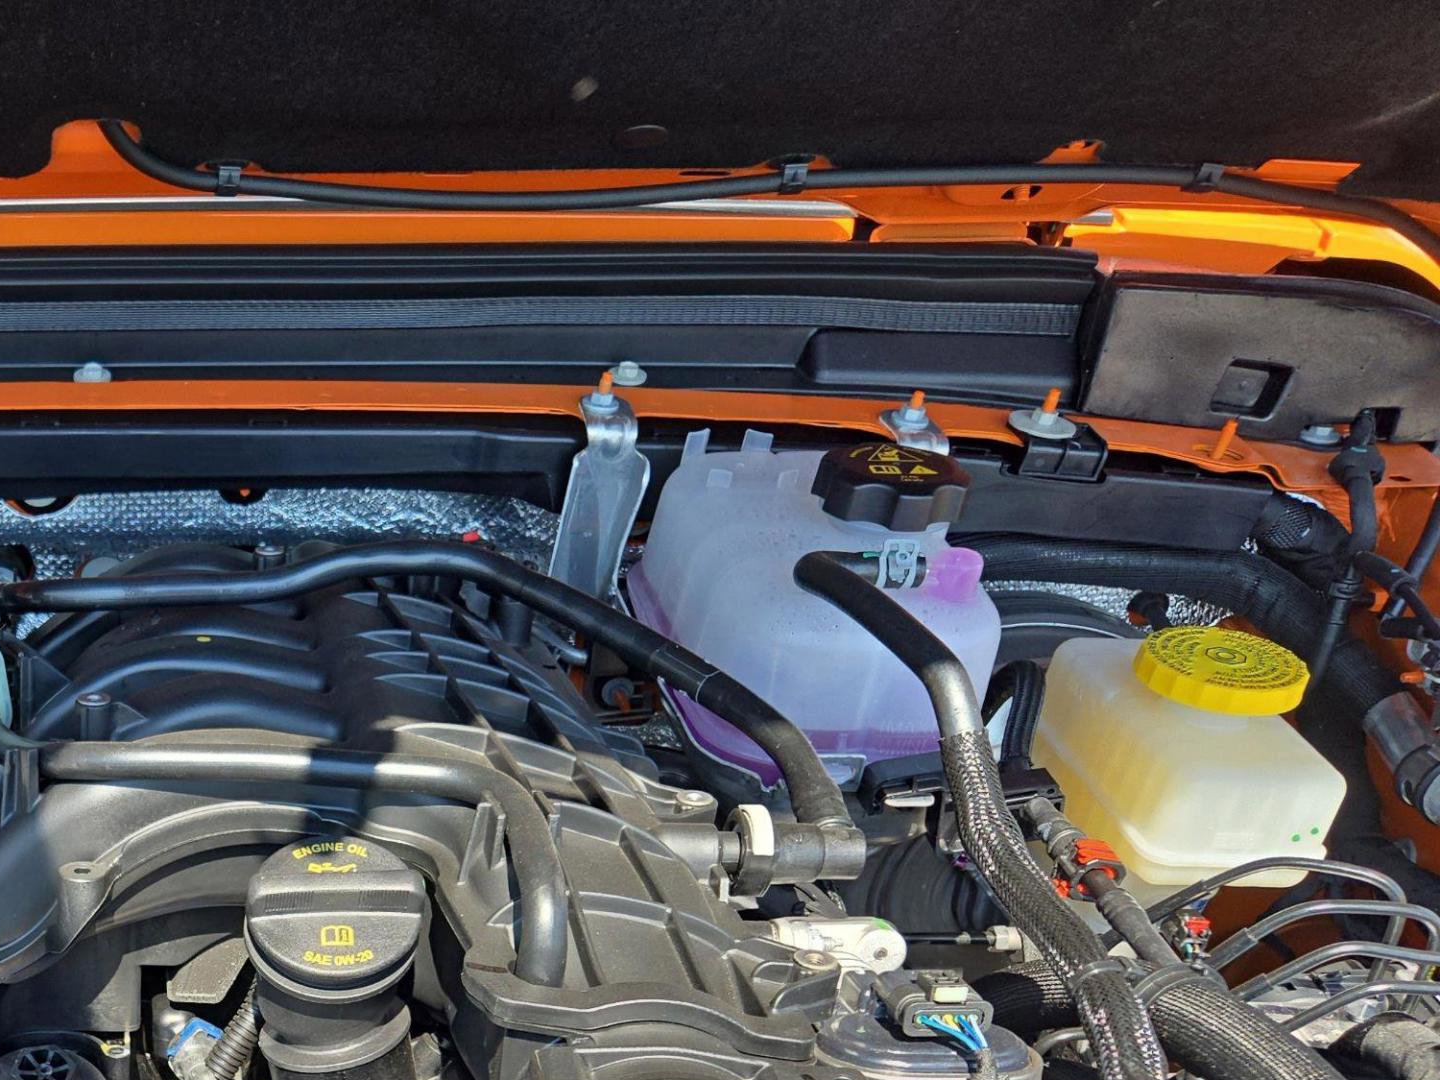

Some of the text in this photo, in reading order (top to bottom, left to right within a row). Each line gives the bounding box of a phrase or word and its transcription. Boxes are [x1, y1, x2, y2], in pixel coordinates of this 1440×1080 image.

[292, 842, 368, 859] ENGINE OIL
[302, 949, 375, 967] SAE 0W-20
